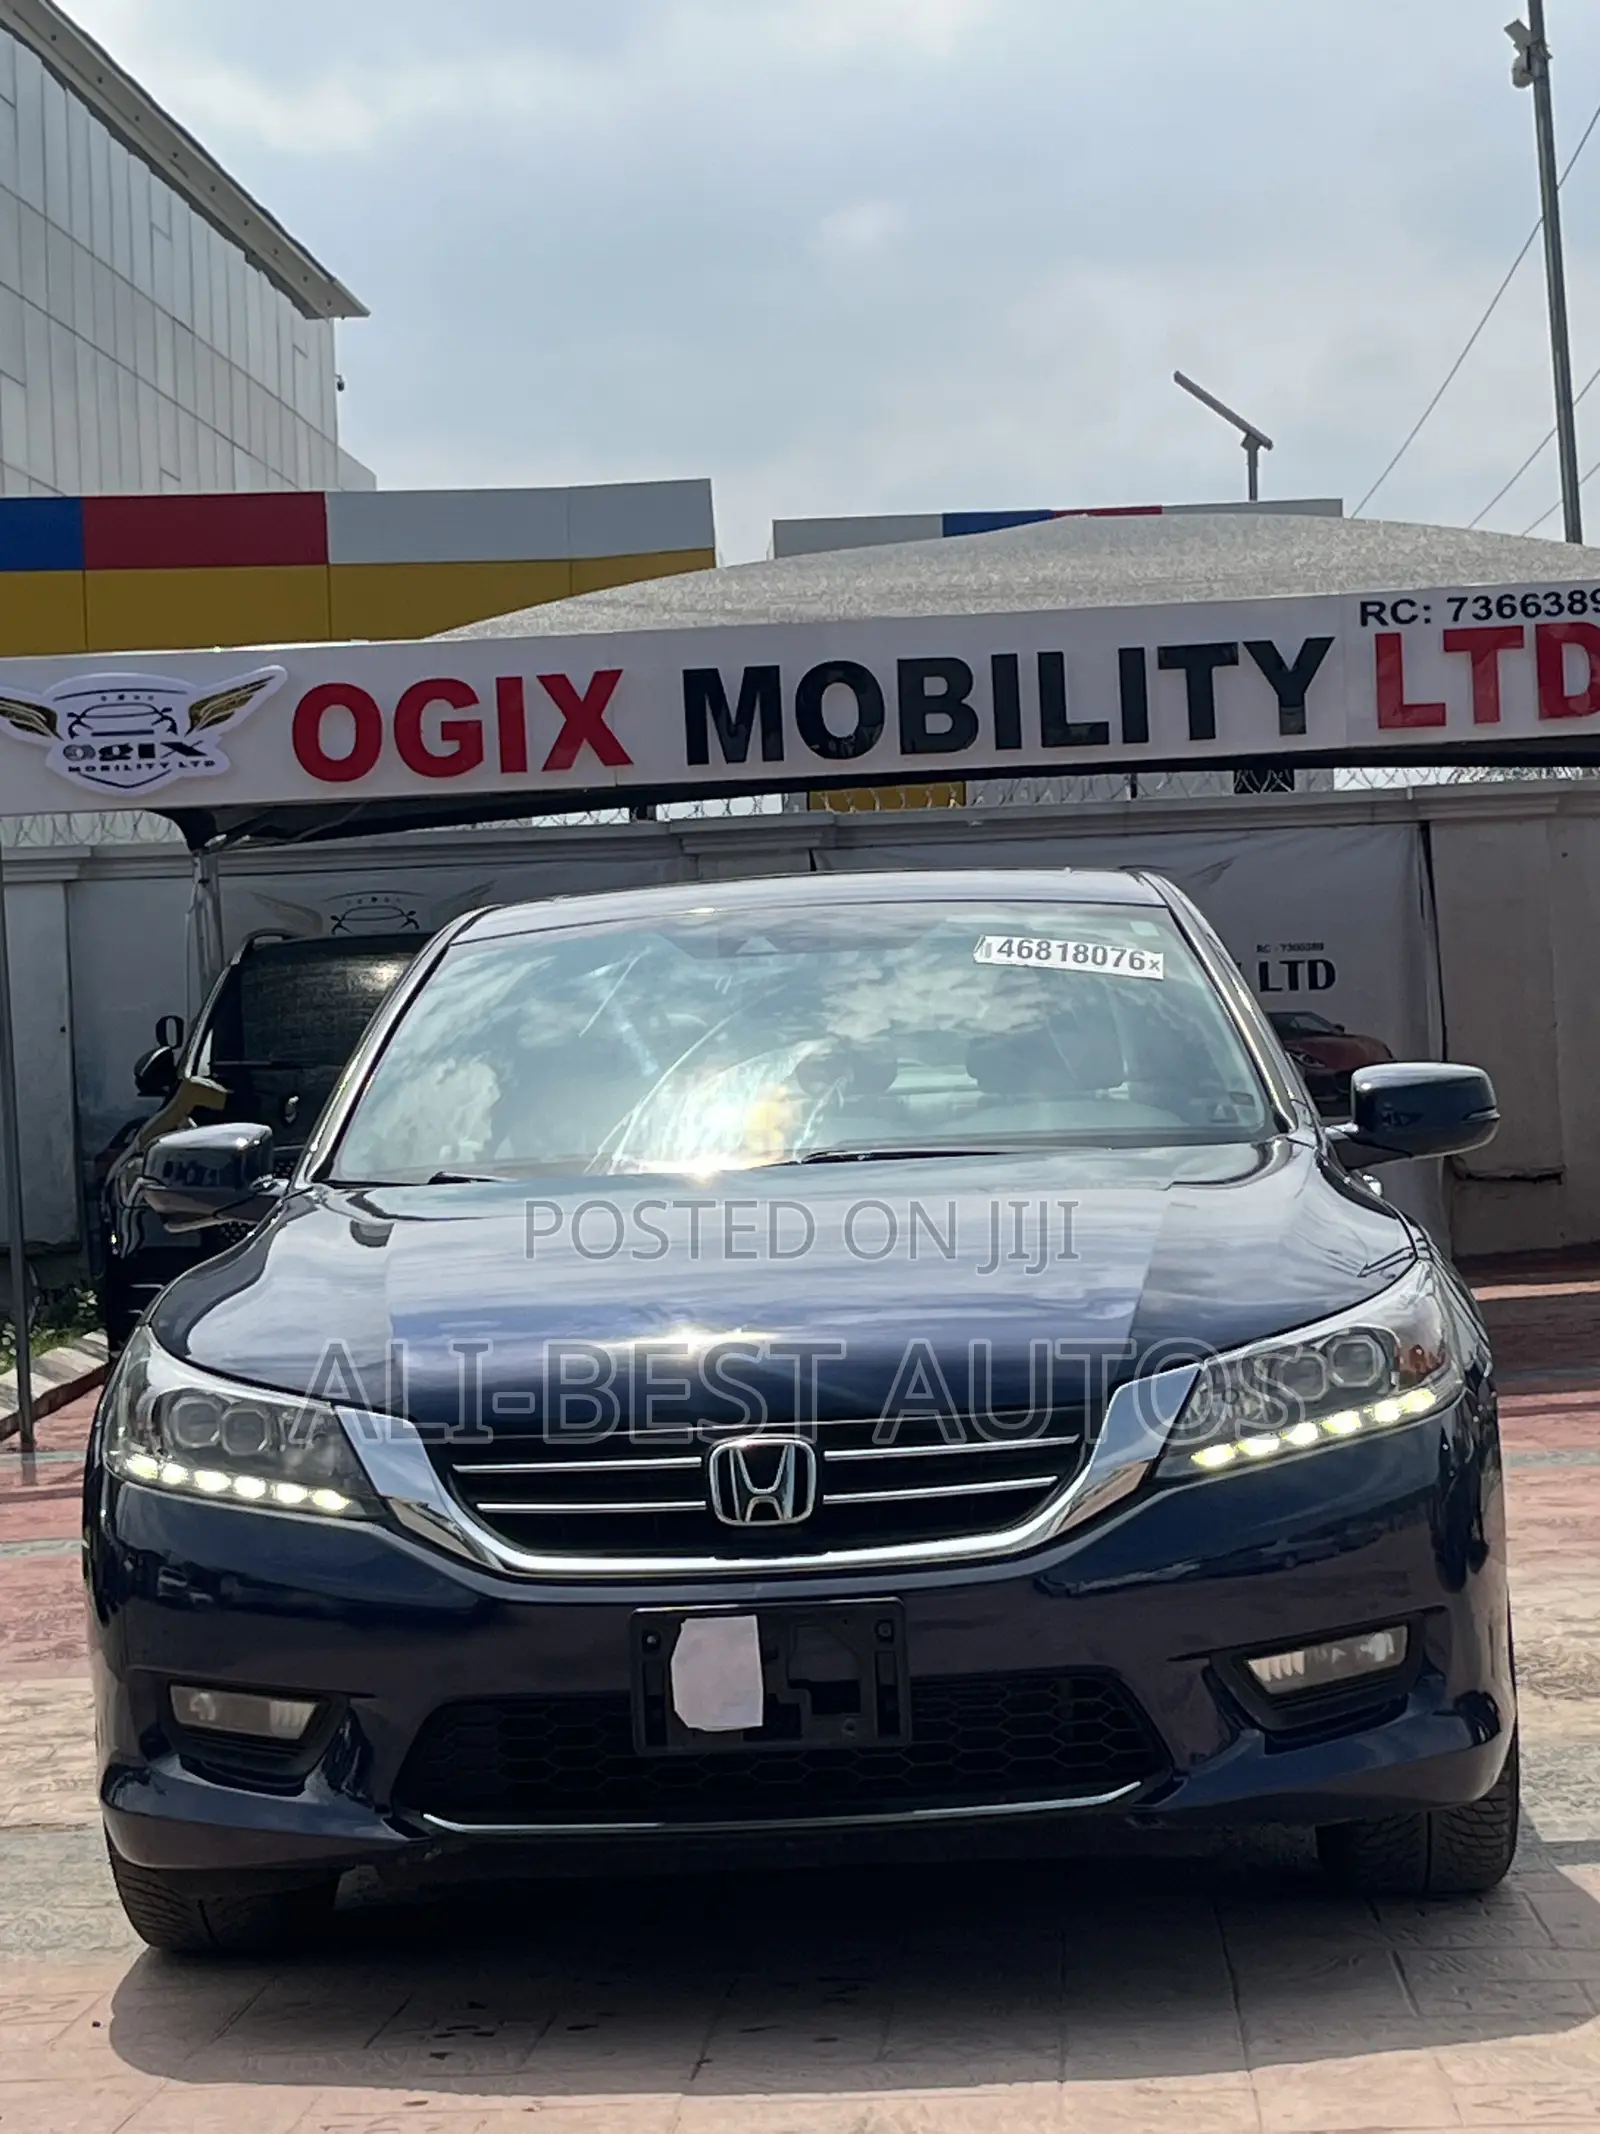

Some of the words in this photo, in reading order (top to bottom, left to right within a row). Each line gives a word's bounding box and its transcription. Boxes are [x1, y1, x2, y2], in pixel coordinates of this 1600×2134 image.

[1360, 598, 1432, 627] RC:
[291, 668, 634, 783] OGIX
[682, 636, 1335, 767] MOBILITY
[1374, 621, 1600, 729] LTD
[1259, 959, 1336, 992] LTD
